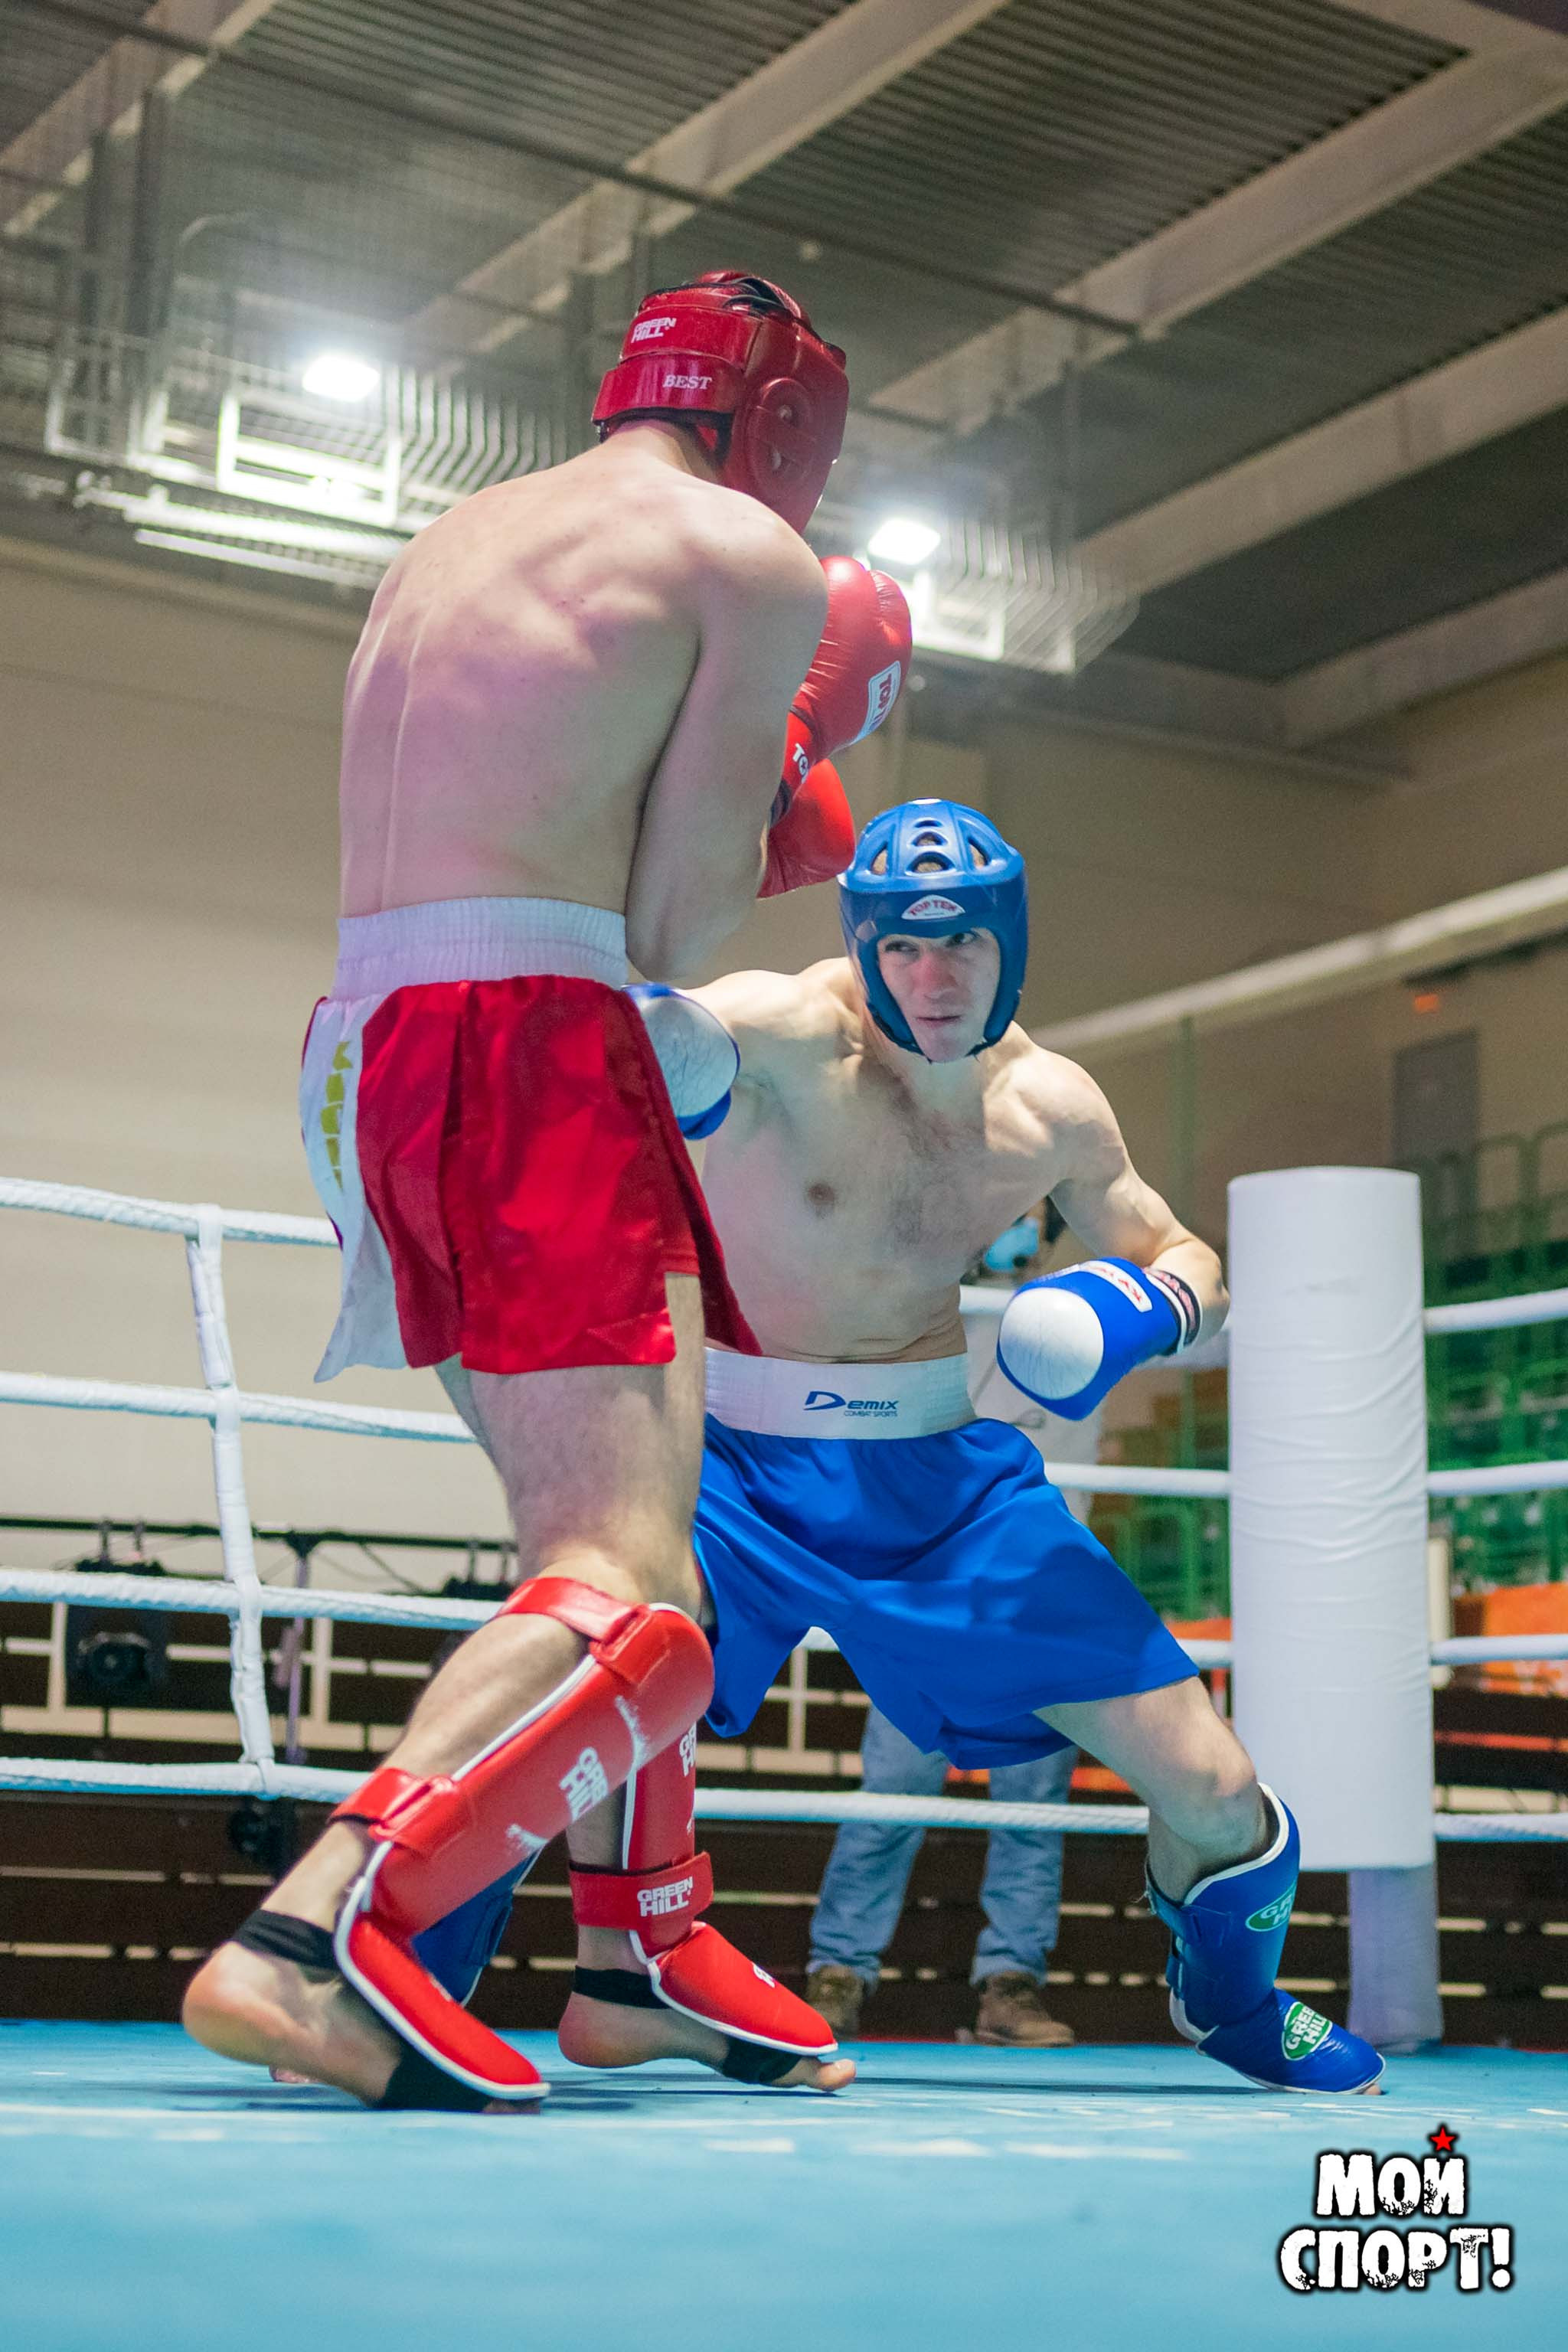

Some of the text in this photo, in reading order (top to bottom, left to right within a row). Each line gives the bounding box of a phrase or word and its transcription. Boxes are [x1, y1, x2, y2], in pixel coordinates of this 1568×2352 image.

[630, 325, 664, 344] HILL
[662, 374, 712, 390] BEST
[910, 900, 930, 915] TOP
[804, 1390, 900, 1410] Demix
[637, 1876, 693, 1902] GREEN
[640, 1892, 689, 1917] HILL
[1285, 2005, 1315, 2050] GREE
